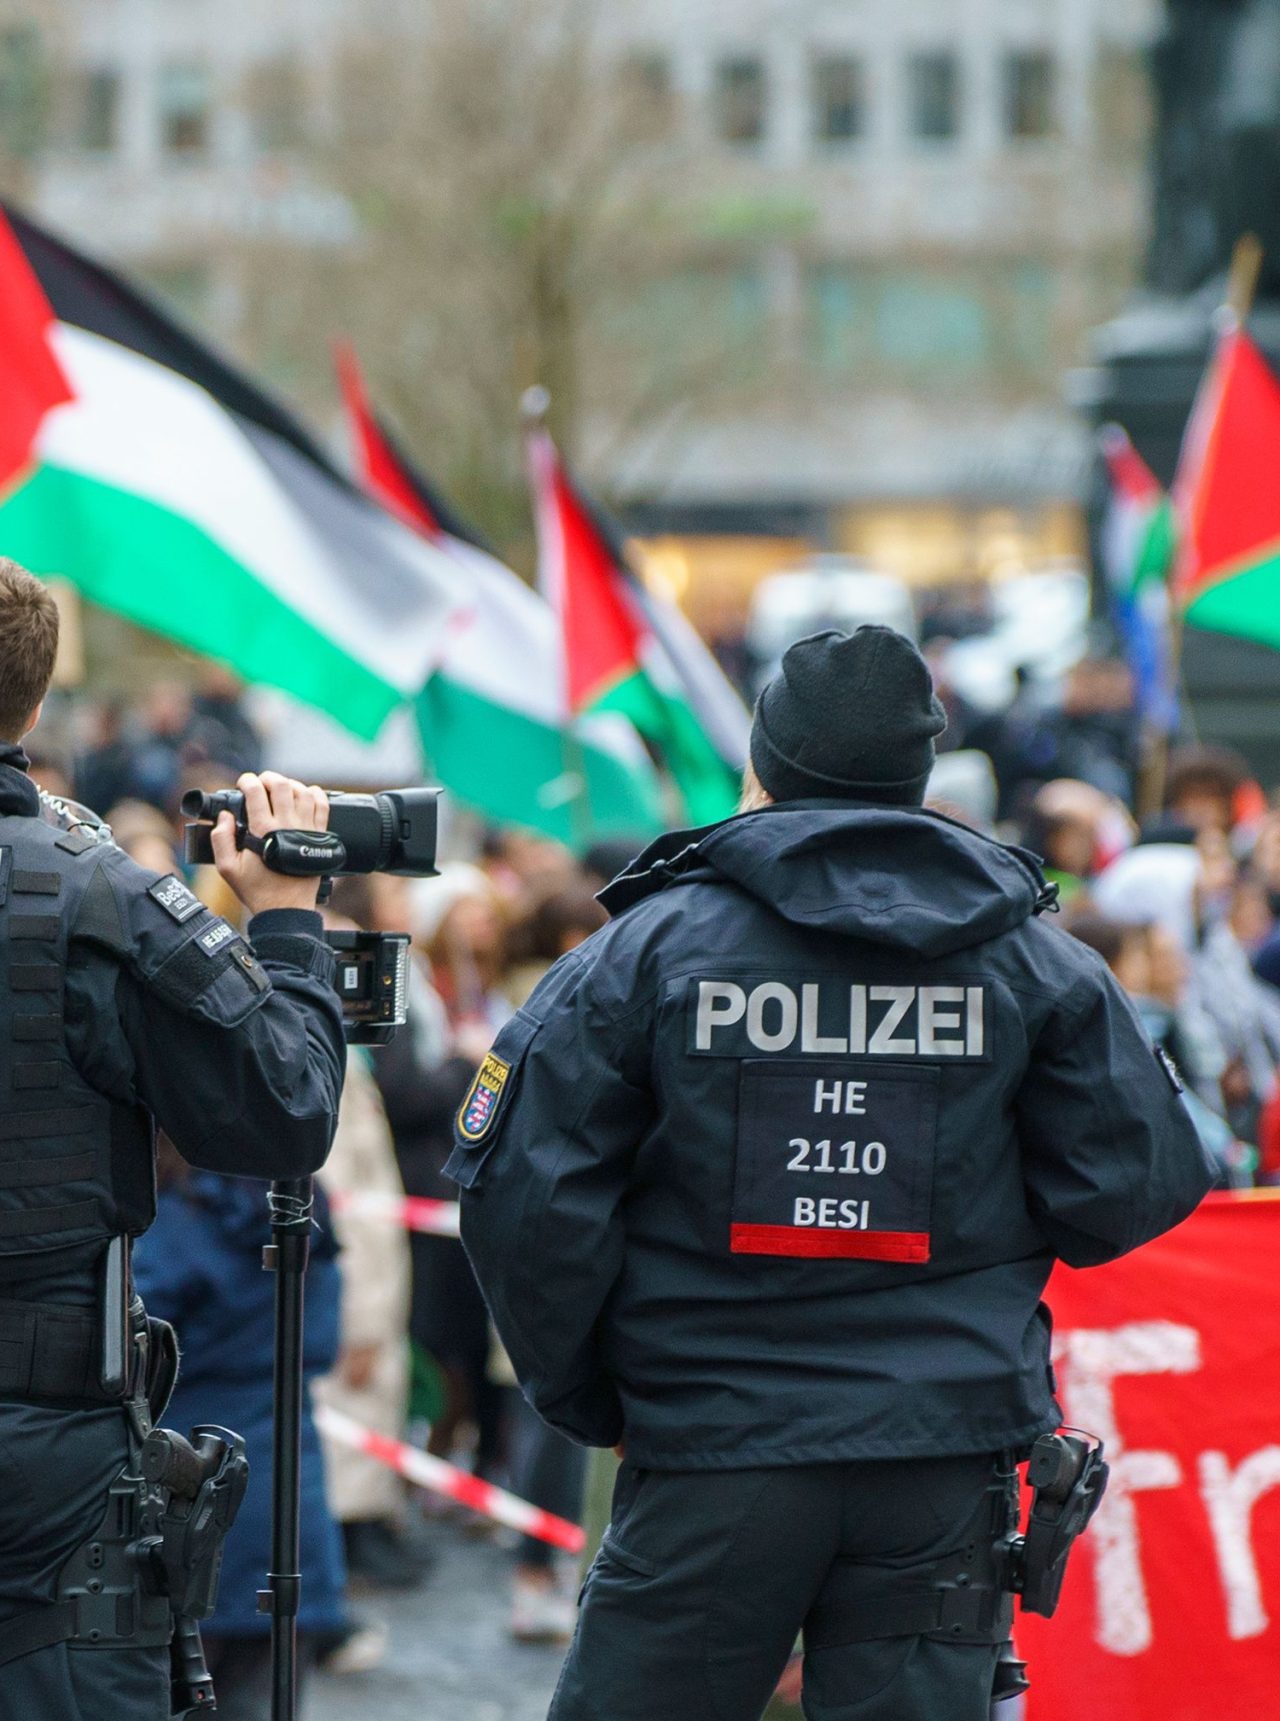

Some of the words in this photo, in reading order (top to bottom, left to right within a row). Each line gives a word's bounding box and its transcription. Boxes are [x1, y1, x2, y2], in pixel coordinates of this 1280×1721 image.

[300, 845, 332, 858] Canon
[696, 981, 984, 1056] POLIZEI
[814, 1079, 867, 1115] HE
[787, 1138, 887, 1175] 2110
[793, 1197, 869, 1230] BESI
